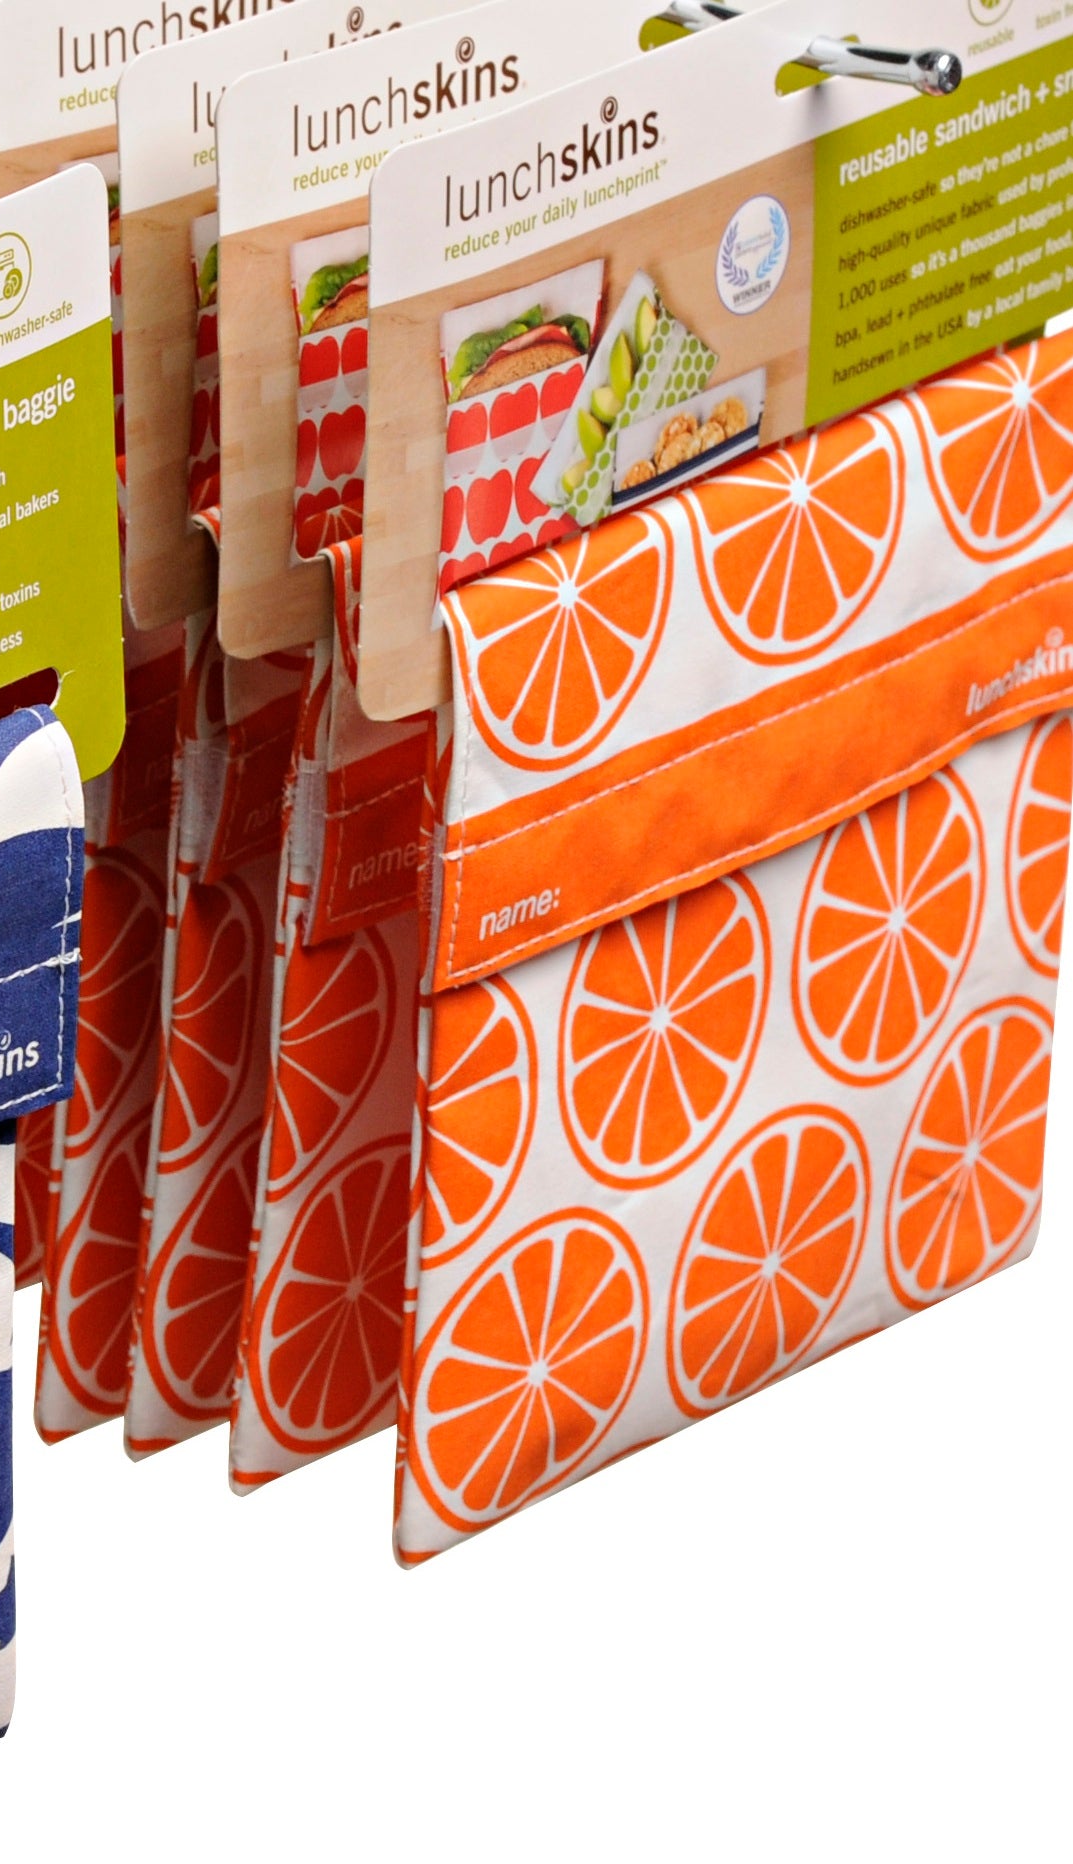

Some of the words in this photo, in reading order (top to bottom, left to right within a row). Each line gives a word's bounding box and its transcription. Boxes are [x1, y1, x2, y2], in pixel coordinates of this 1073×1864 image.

[293, 36, 520, 157] lunchskins
[444, 96, 659, 228] lunchskins
[839, 128, 928, 186] reusable
[934, 84, 1031, 147] sandwich
[293, 162, 349, 191] reduce
[839, 181, 937, 234] dishwasher-safe
[940, 175, 955, 193] so
[1002, 143, 1022, 166] not
[444, 230, 500, 262] reduce
[505, 216, 537, 242] your
[542, 196, 578, 225] daily
[838, 230, 911, 272] high-quality
[915, 211, 957, 240] unique
[961, 196, 995, 220] fabric
[732, 280, 771, 304] WINNER
[835, 327, 861, 348] bpa,
[866, 310, 893, 334] lead
[909, 281, 965, 320] phthalate
[969, 270, 992, 289] free
[838, 280, 876, 311] 1,000
[880, 269, 907, 292] uses
[911, 261, 926, 279] so
[832, 348, 894, 385] handsewn
[898, 341, 910, 356] in
[913, 329, 933, 349] the
[937, 315, 964, 339] USA
[3, 374, 77, 432] baggie
[15, 488, 60, 521] bakers
[0, 580, 42, 612] toxins
[478, 885, 562, 942] name:
